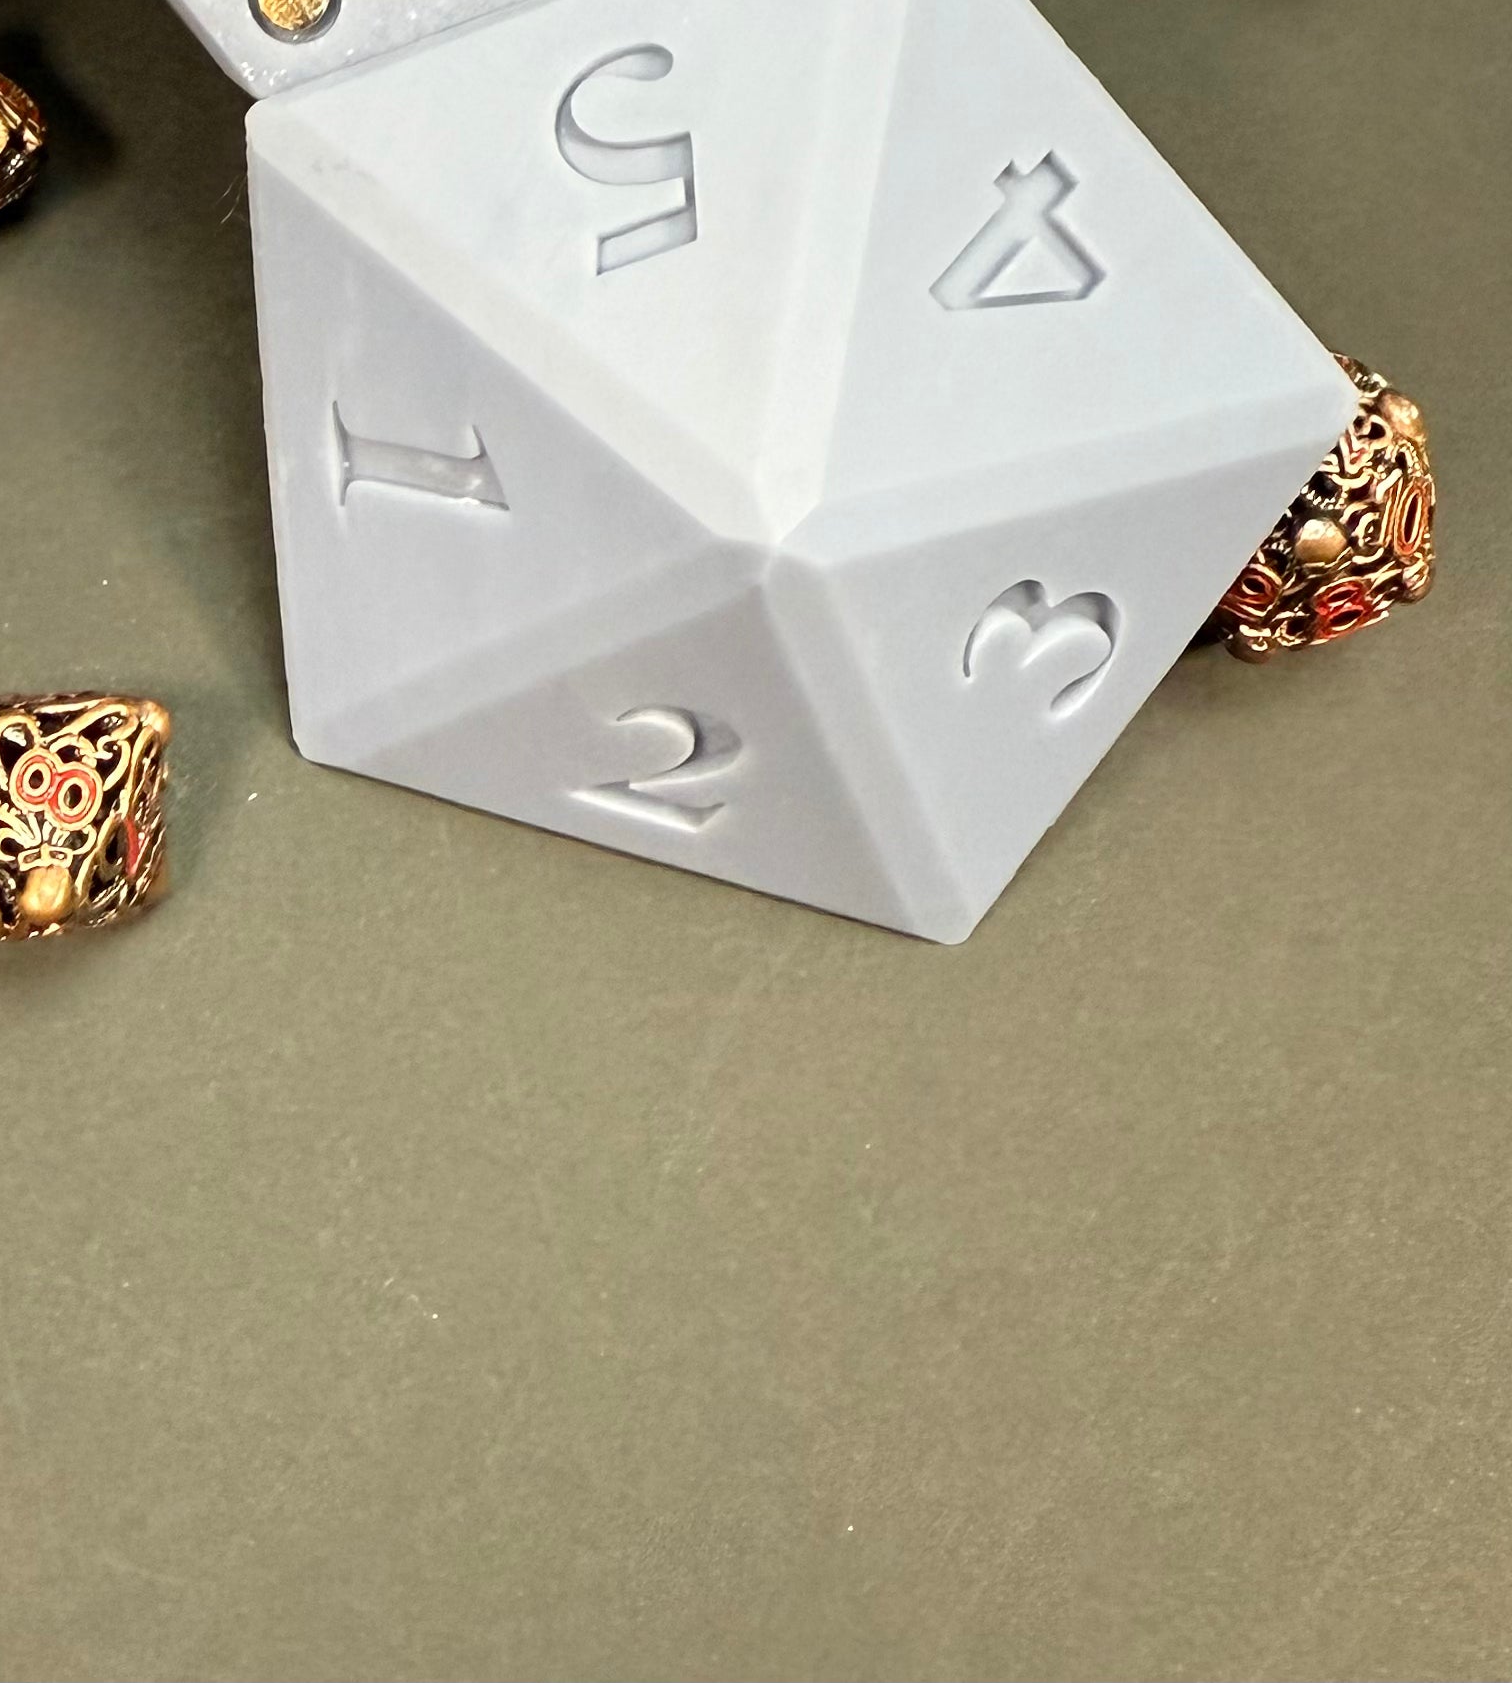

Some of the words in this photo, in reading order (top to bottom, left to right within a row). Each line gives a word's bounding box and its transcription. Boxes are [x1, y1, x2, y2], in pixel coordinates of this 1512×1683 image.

[555, 42, 698, 276] 5
[929, 149, 1108, 312] 4
[331, 399, 510, 512] 1
[962, 579, 1125, 720] 3
[568, 704, 744, 834] 2
